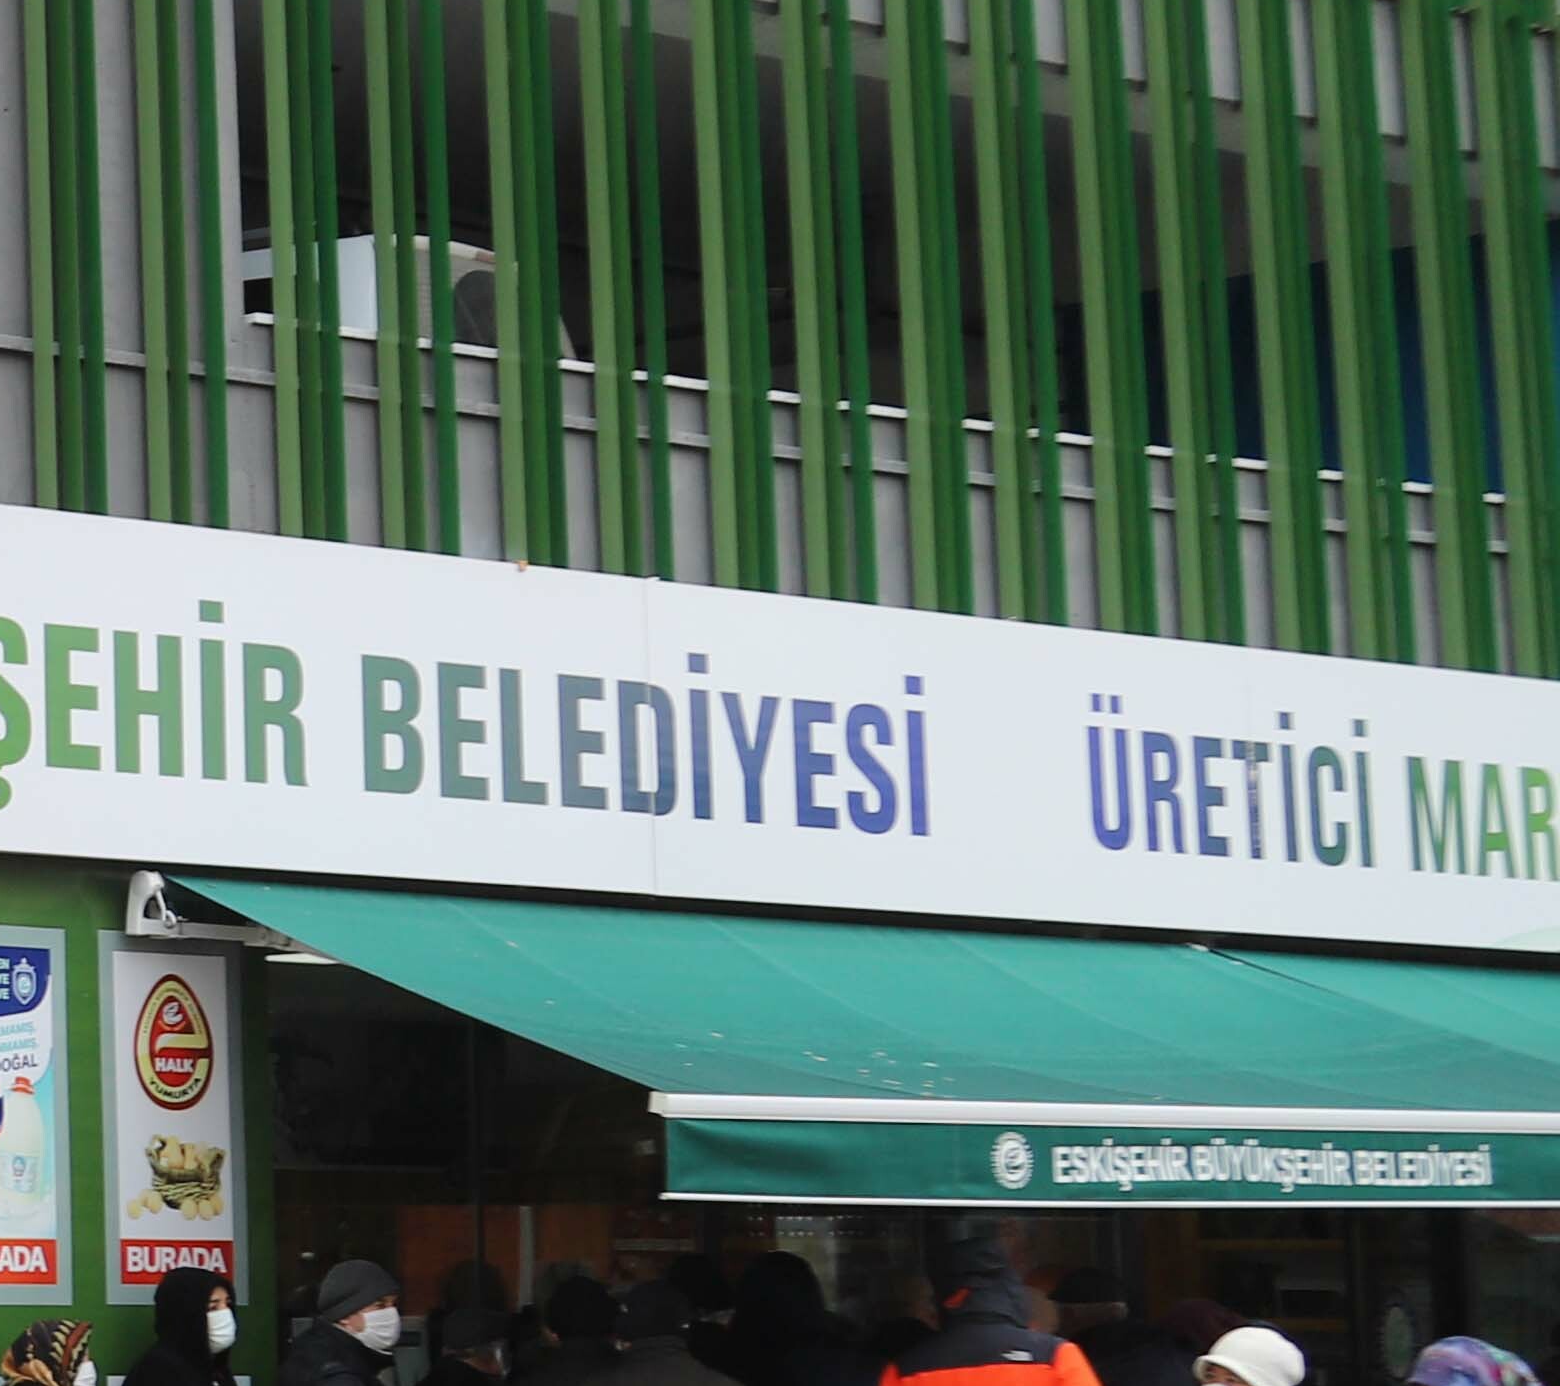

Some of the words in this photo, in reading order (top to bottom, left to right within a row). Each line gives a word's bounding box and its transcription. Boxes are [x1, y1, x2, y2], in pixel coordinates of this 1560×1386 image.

[362, 652, 931, 836] BELEDİYESİ
[1086, 692, 1375, 868] ÜRETİCİ
[155, 1057, 195, 1073] HALK
[1052, 1137, 1192, 1192] ESKİŞEHİR
[1191, 1137, 1354, 1193] BÜYÜKŞEHİR
[1354, 1144, 1493, 1186] BELEDİYESİ
[127, 1246, 227, 1273] BURADA
